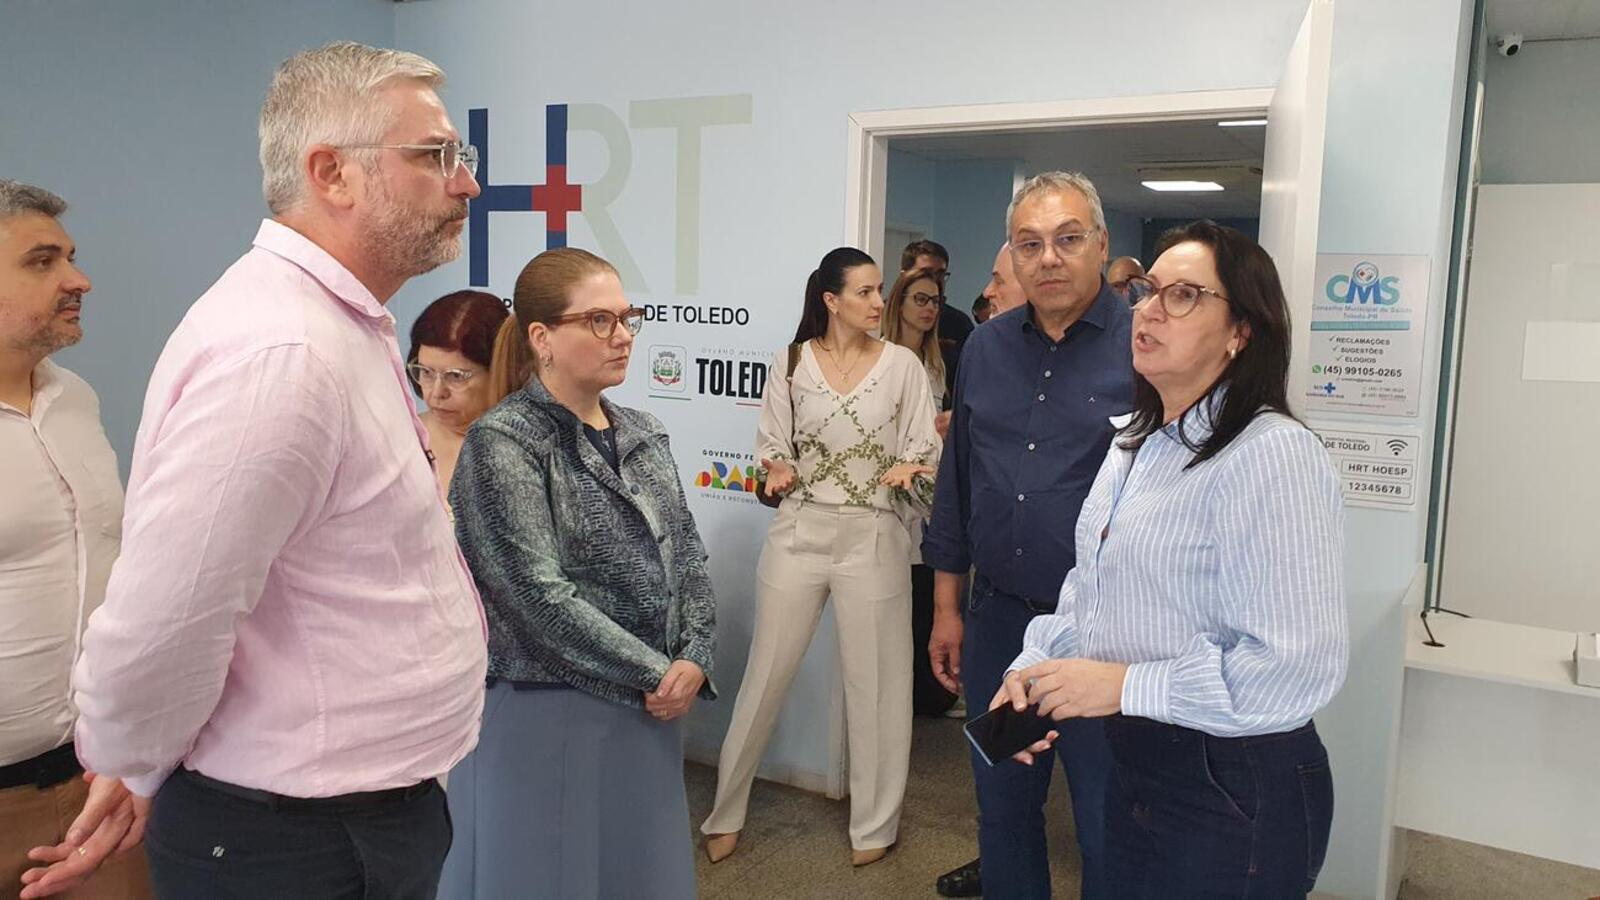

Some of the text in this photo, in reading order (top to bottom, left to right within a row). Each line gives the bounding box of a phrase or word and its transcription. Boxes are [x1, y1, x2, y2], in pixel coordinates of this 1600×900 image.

[469, 94, 752, 295] HRT
[1326, 274, 1400, 305] CMS
[644, 305, 749, 325] DE TOLEDO
[1336, 336, 1390, 345] RECLAMAÇÕES
[1341, 346, 1384, 355] SUGESTÕES
[1344, 356, 1376, 364] ELOGIOS
[1323, 366, 1402, 378] (45) 99105-0265
[696, 358, 772, 399] TOLED
[1325, 441, 1370, 451] DE TOLEDO
[702, 449, 741, 459] GOVERNO
[1348, 463, 1408, 475] HRT HOESP
[1349, 482, 1402, 495] 12345678
